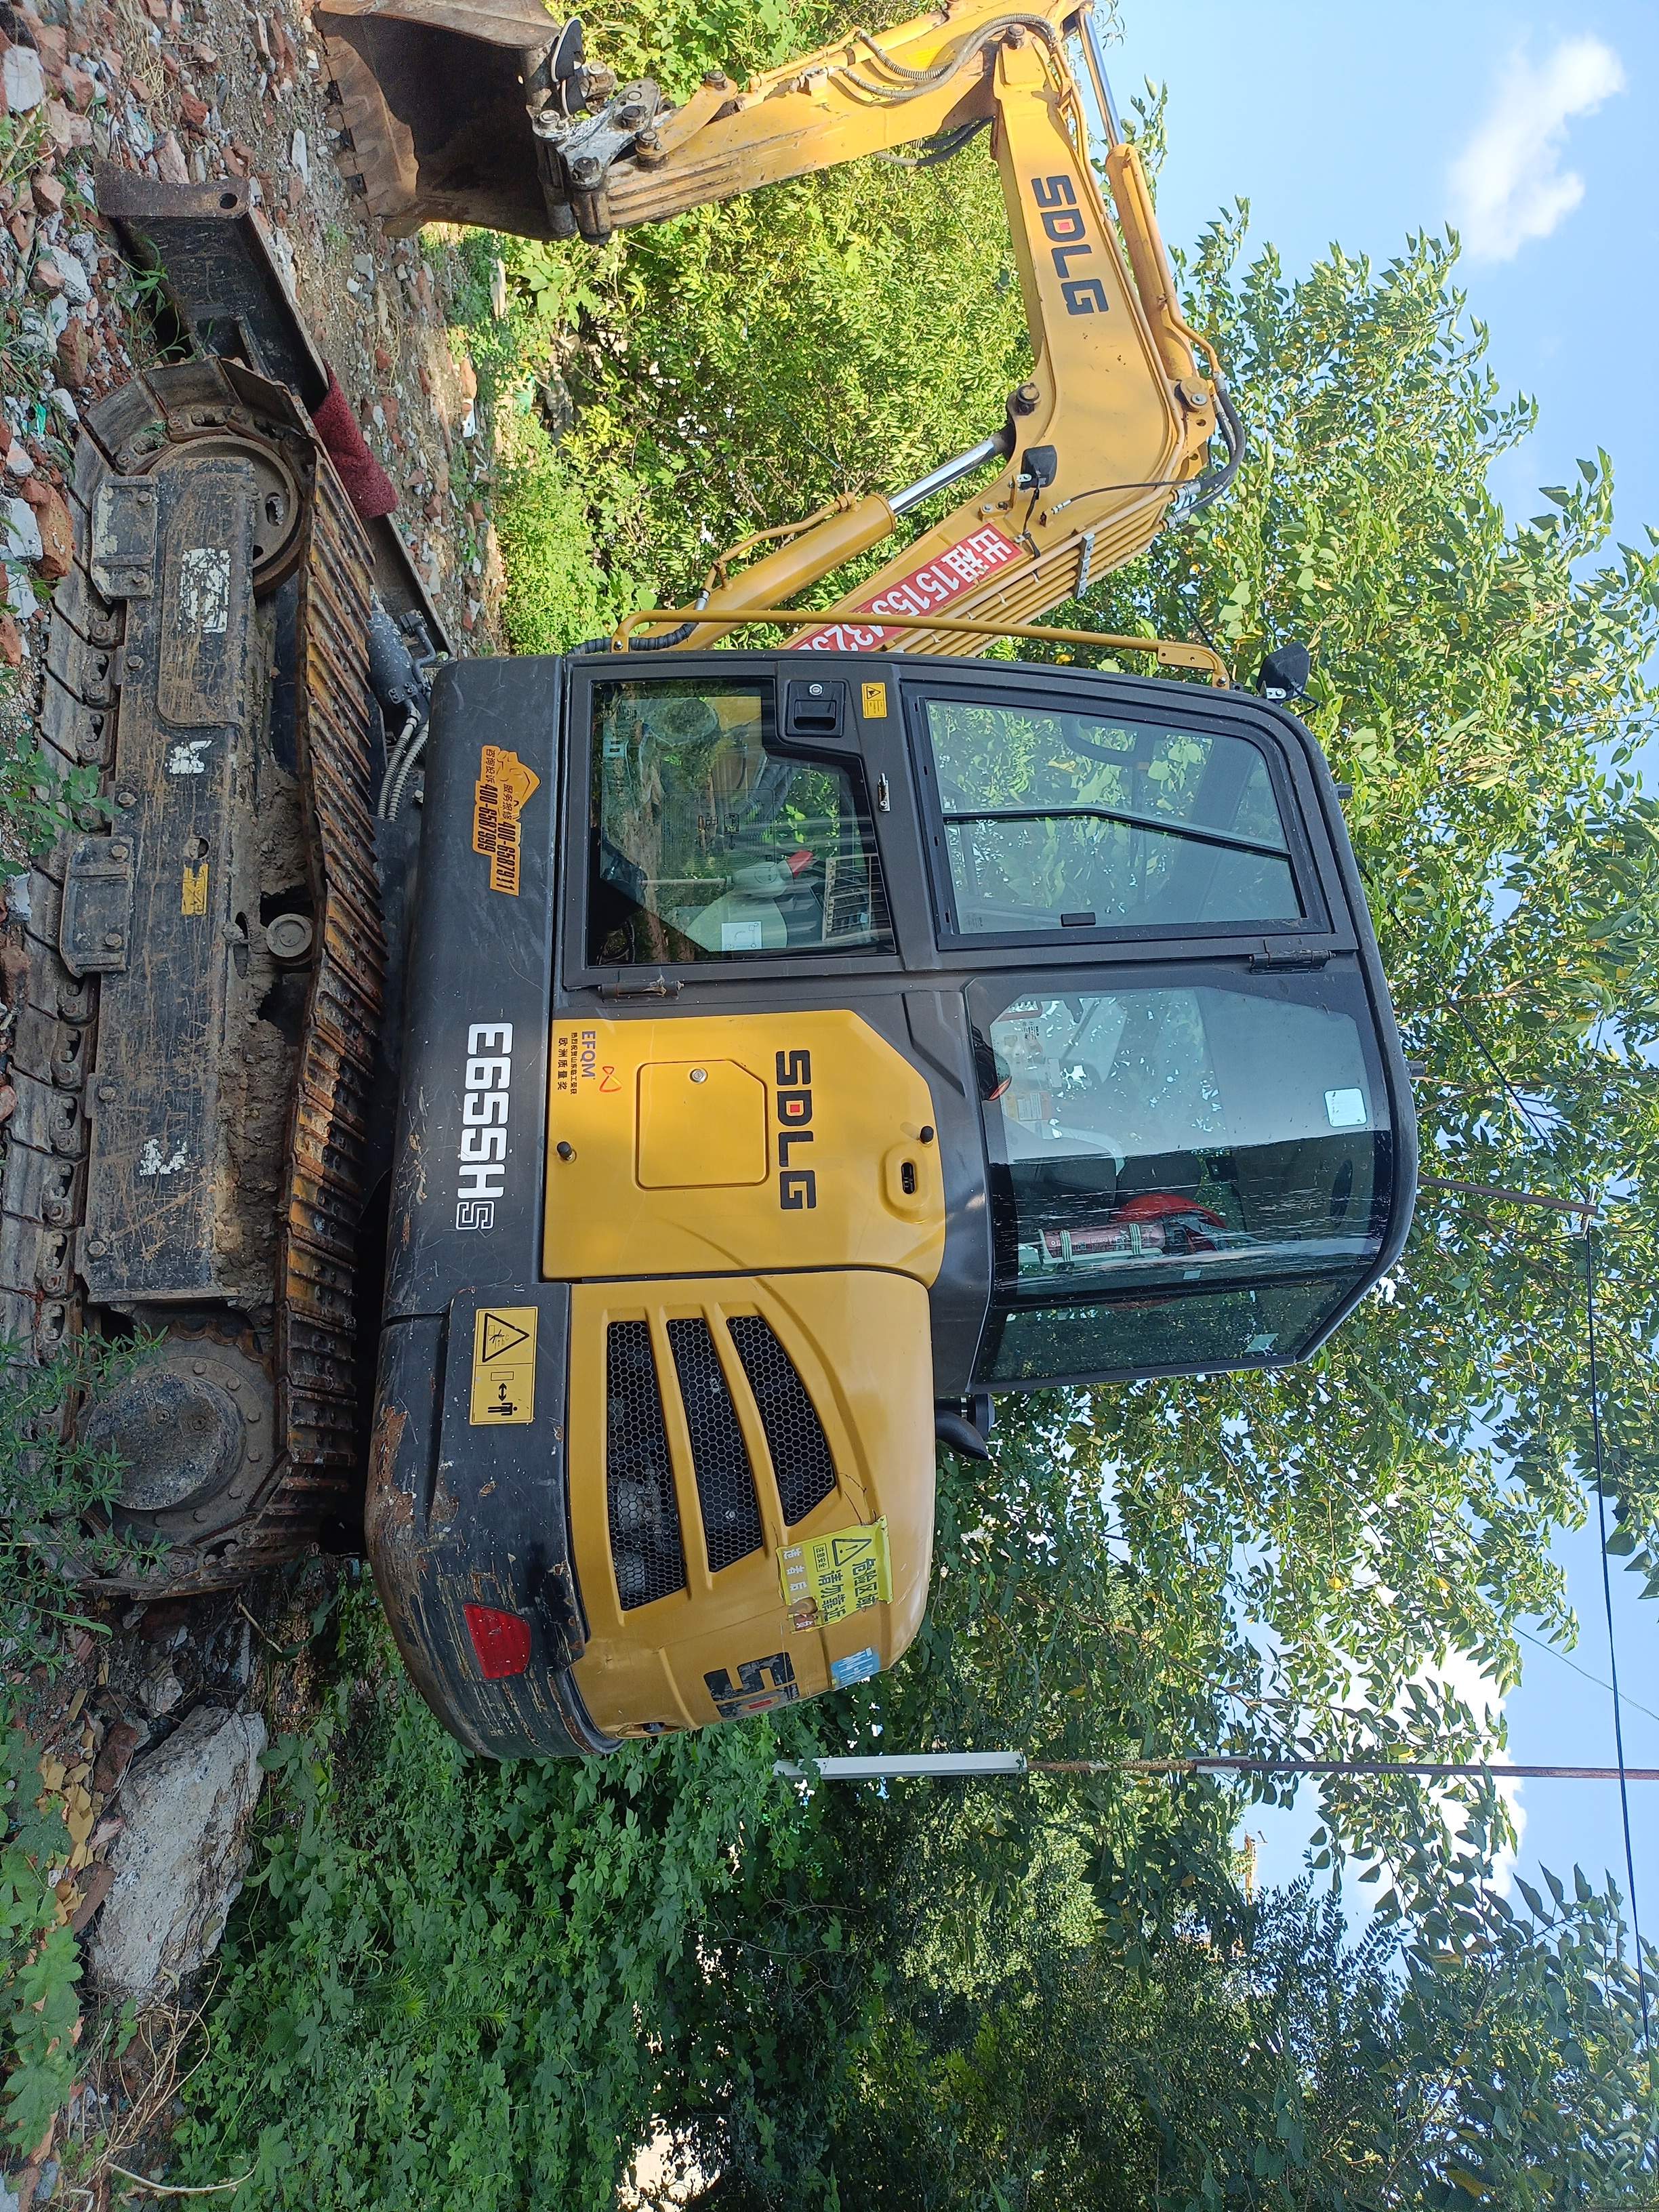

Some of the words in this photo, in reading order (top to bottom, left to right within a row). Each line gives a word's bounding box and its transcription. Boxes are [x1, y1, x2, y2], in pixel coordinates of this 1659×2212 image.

[1031, 175, 1109, 316] SDLG
[485, 749, 496, 783] 咨询投诉
[477, 783, 498, 853] 400-6587999
[502, 783, 514, 820] 服务报修
[495, 821, 516, 891] 400-6587911
[558, 1038, 568, 1091] 欧洲质量奖
[570, 1032, 578, 1095] 热烈祝贺山东临工荣获
[580, 1031, 597, 1078] EFQM
[775, 1050, 817, 1210] SDLG
[815, 1547, 825, 1570] 注意安全
[817, 1569, 846, 1622] 请勿靠近
